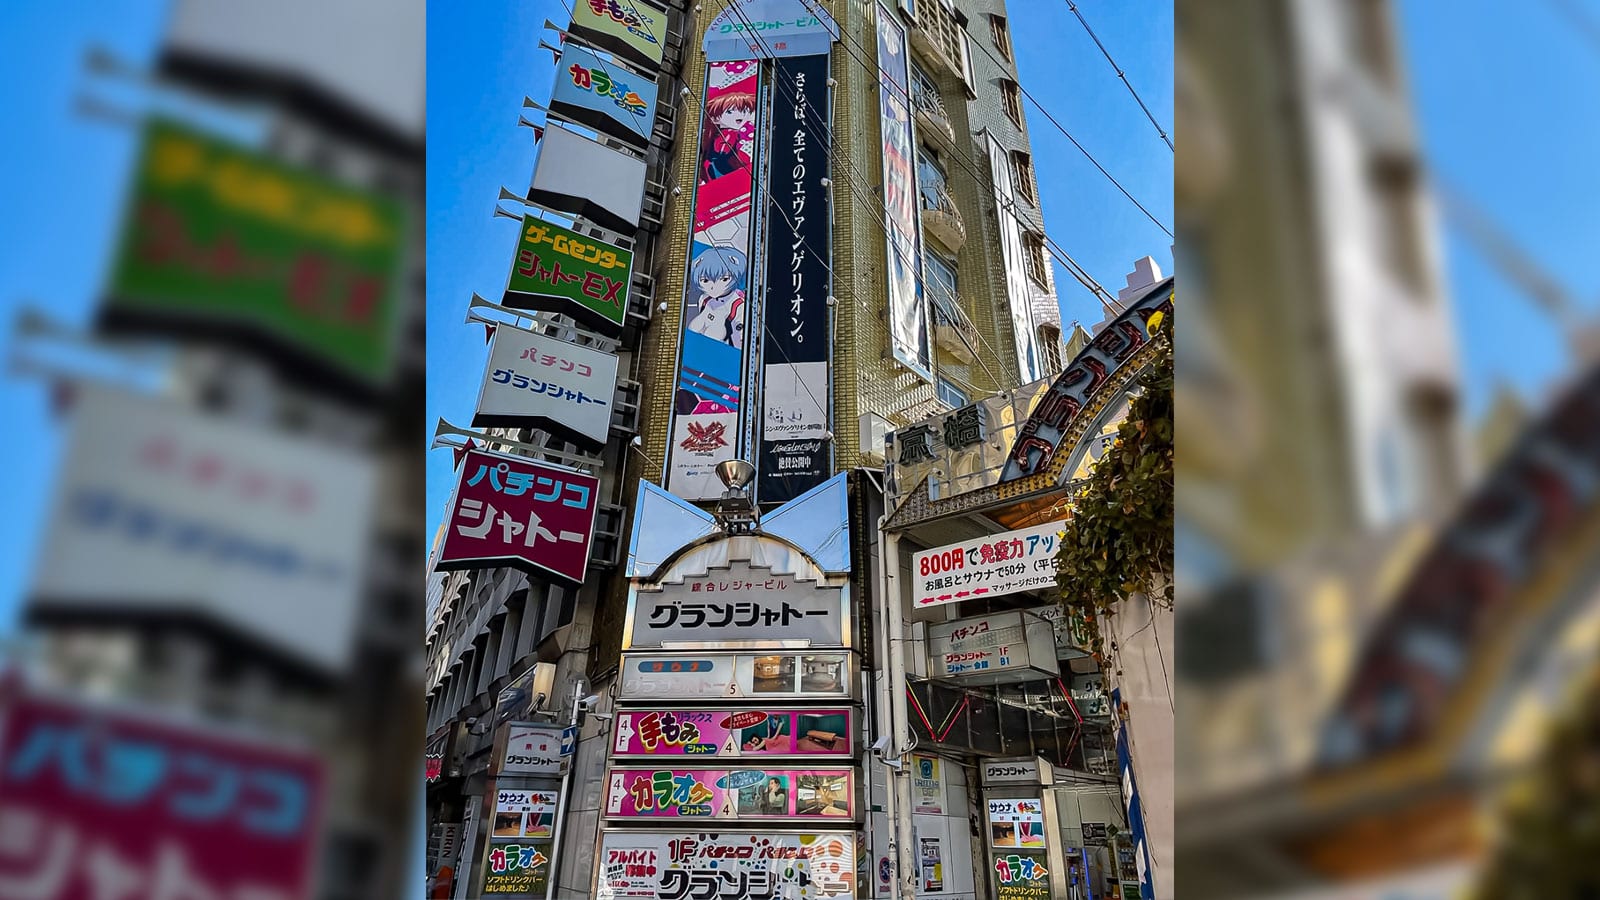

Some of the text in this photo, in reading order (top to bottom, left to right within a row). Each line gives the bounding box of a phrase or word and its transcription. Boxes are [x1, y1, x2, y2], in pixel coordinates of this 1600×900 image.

[568, 63, 648, 109] カラオケ
[525, 225, 626, 269] ゲームセンター
[519, 347, 593, 378] パチンコ
[492, 369, 608, 406] グランシャトー
[467, 462, 591, 511] パチンコ
[456, 498, 585, 547] シャトー
[920, 535, 1060, 577] 800円で免疫力アッ
[648, 601, 829, 629] グランシャトー
[950, 621, 990, 642] パチンコ
[999, 647, 1009, 655] 1F
[729, 684, 736, 695] 5
[678, 712, 713, 723] リラックス
[639, 712, 700, 749] 手もみ
[687, 744, 716, 753] シャトー
[725, 743, 732, 752] 4
[506, 755, 560, 765] グランシャトー
[987, 767, 1036, 776] グランシャトー
[498, 792, 525, 804] サウナ
[631, 771, 713, 811] カラオケ
[681, 806, 711, 816] シャトー
[722, 804, 730, 815] 4
[990, 803, 1012, 813] サウナ
[442, 826, 455, 858] KIRIN
[667, 839, 699, 863] 1F
[489, 845, 548, 873] カラオケ
[609, 850, 657, 864] アルバイト
[995, 855, 1049, 883] カラオケ
[487, 876, 543, 884] ソフトドリンクバー
[998, 886, 1049, 896] ソフトドリンクバー
